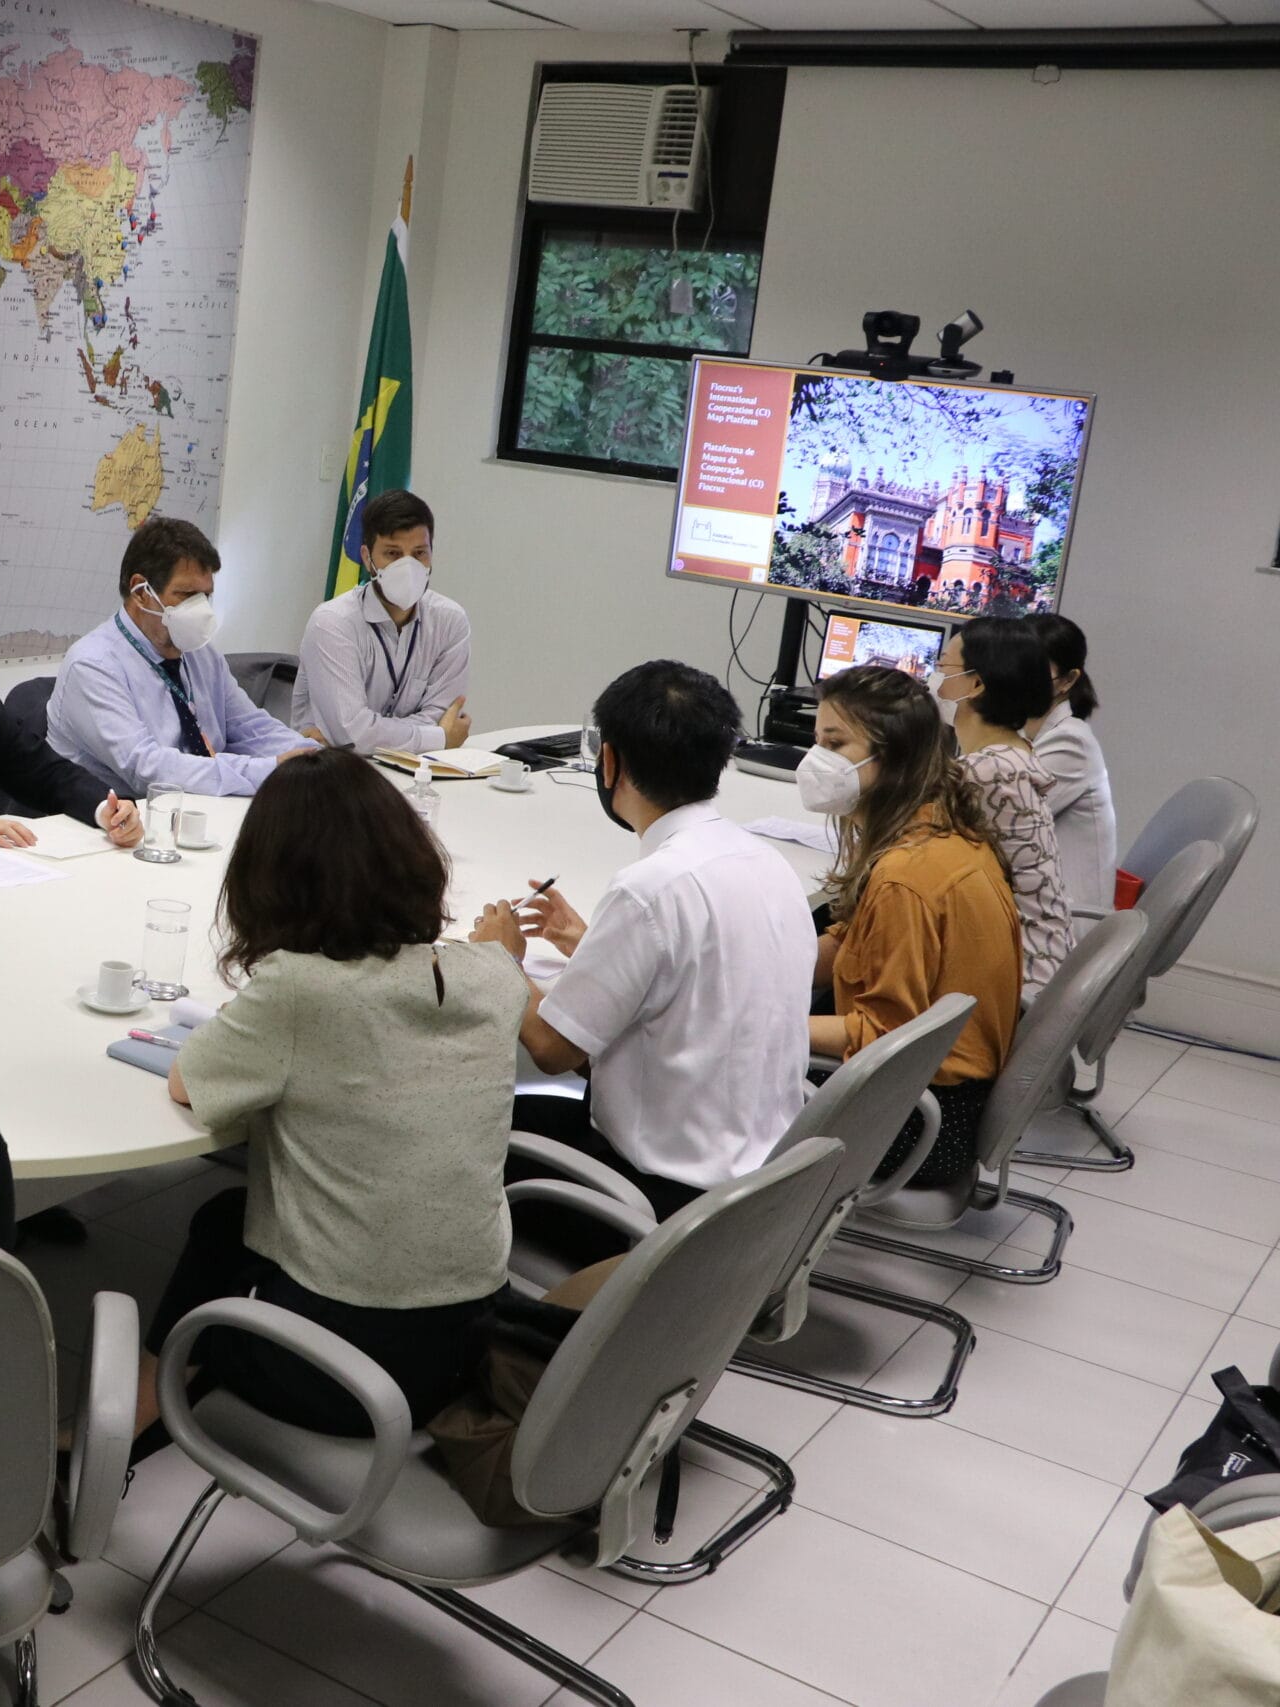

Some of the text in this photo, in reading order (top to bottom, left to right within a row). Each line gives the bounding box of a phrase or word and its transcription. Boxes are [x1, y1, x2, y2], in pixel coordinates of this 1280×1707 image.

[4, 351, 60, 364] INDIAN
[709, 393, 757, 405] International
[708, 403, 754, 415] Cooperation
[14, 418, 58, 429] OCEAN
[706, 412, 759, 426] Map Platform
[703, 442, 755, 456] Plataforma de
[702, 452, 737, 464] Mapas da
[700, 462, 745, 475] Cooperação
[699, 472, 747, 487] Internacional
[698, 482, 725, 493] Fiocruz
